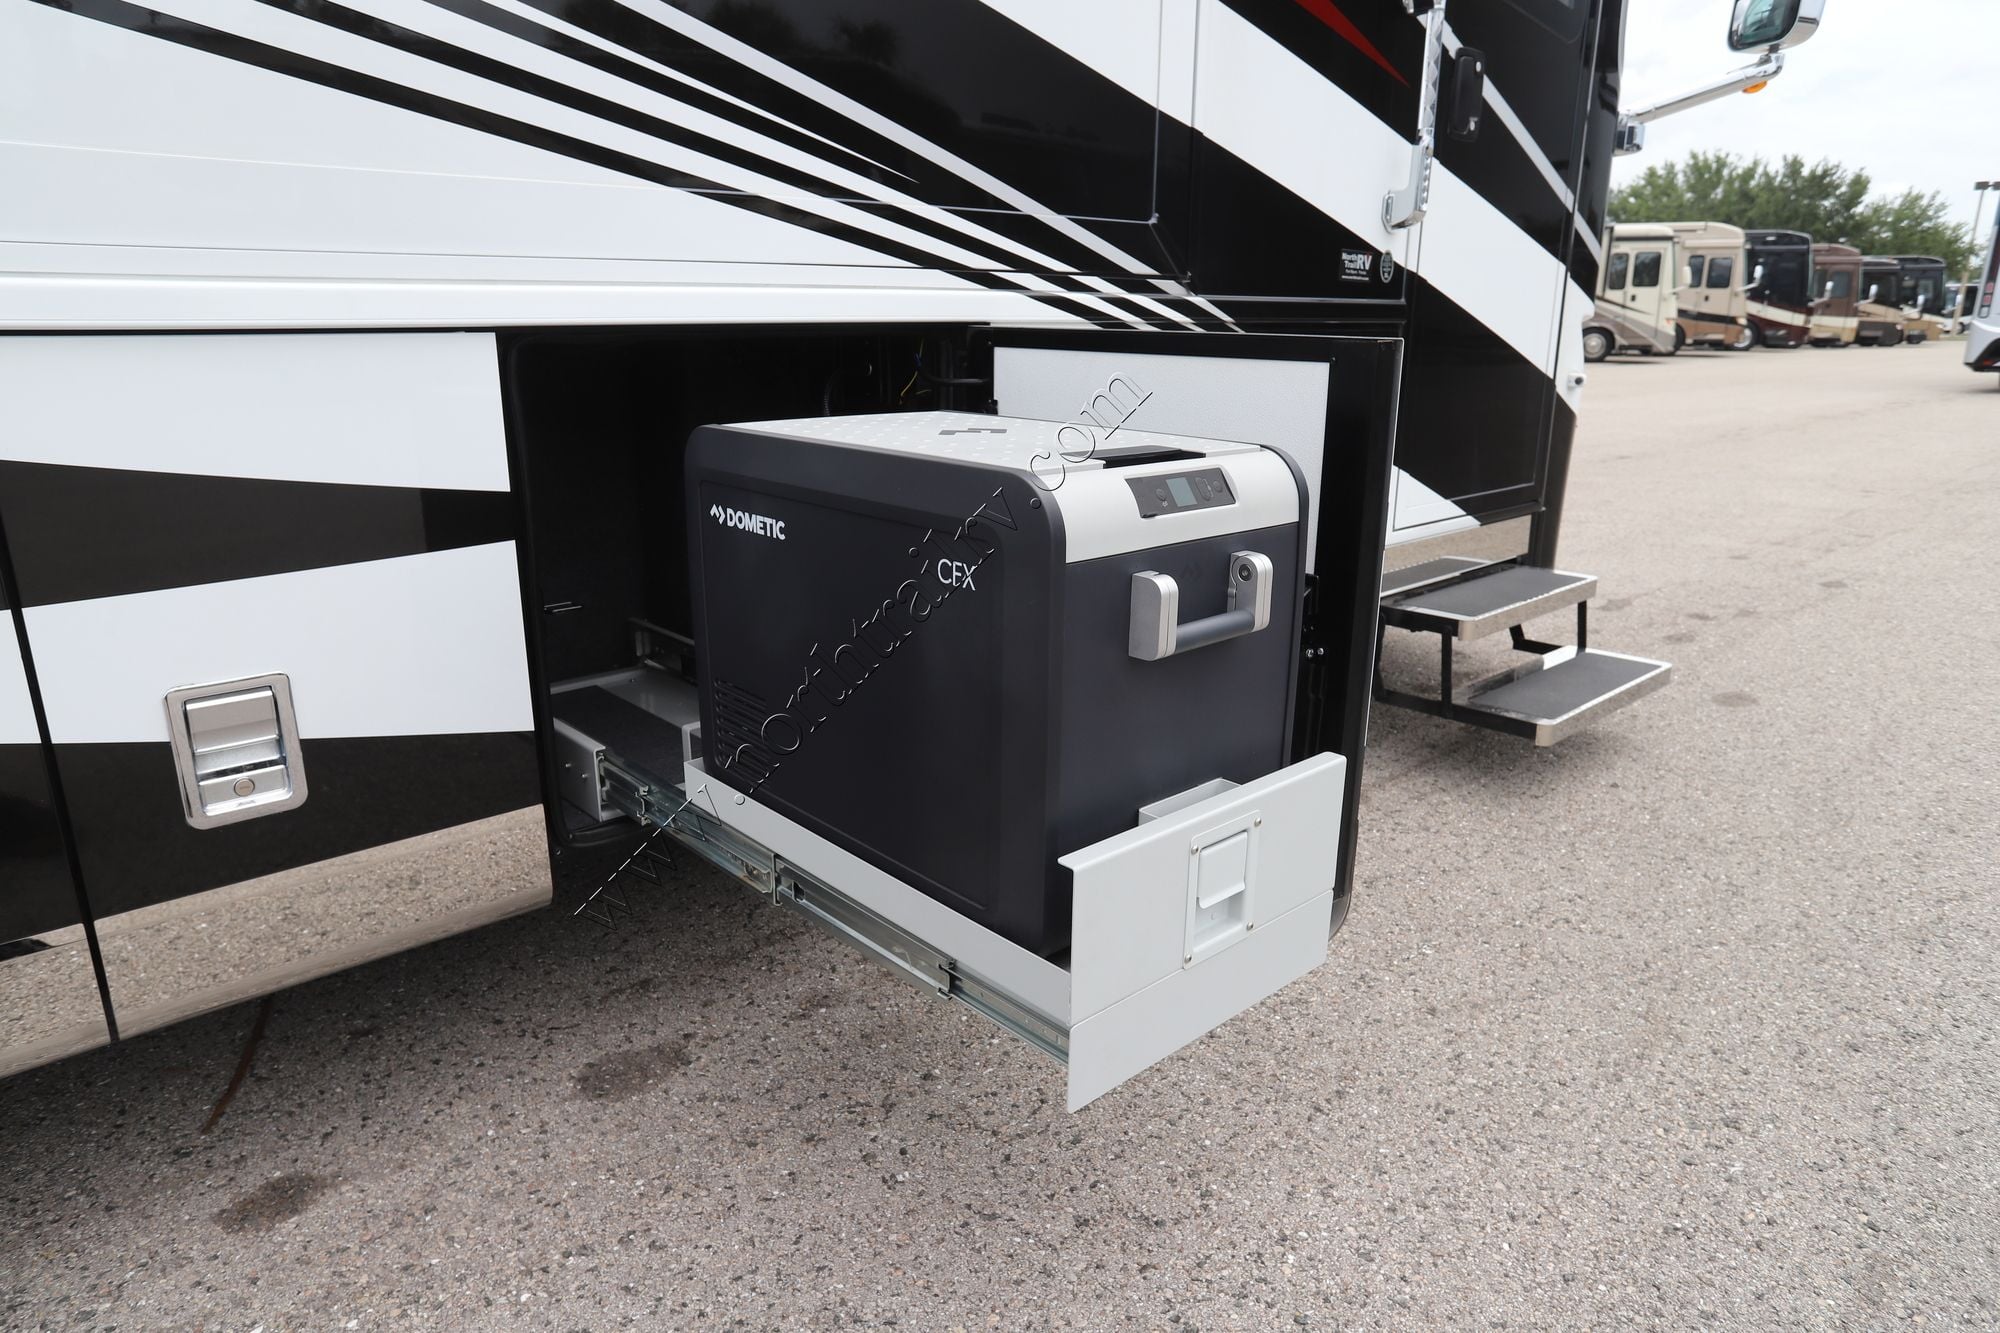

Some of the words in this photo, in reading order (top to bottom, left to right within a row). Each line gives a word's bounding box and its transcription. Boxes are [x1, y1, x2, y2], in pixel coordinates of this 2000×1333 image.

[1341, 252, 1358, 261] North
[1344, 260, 1358, 269] Trail
[1357, 254, 1372, 270] RV
[726, 507, 786, 541] DOMETIC
[937, 558, 976, 591] CFX
